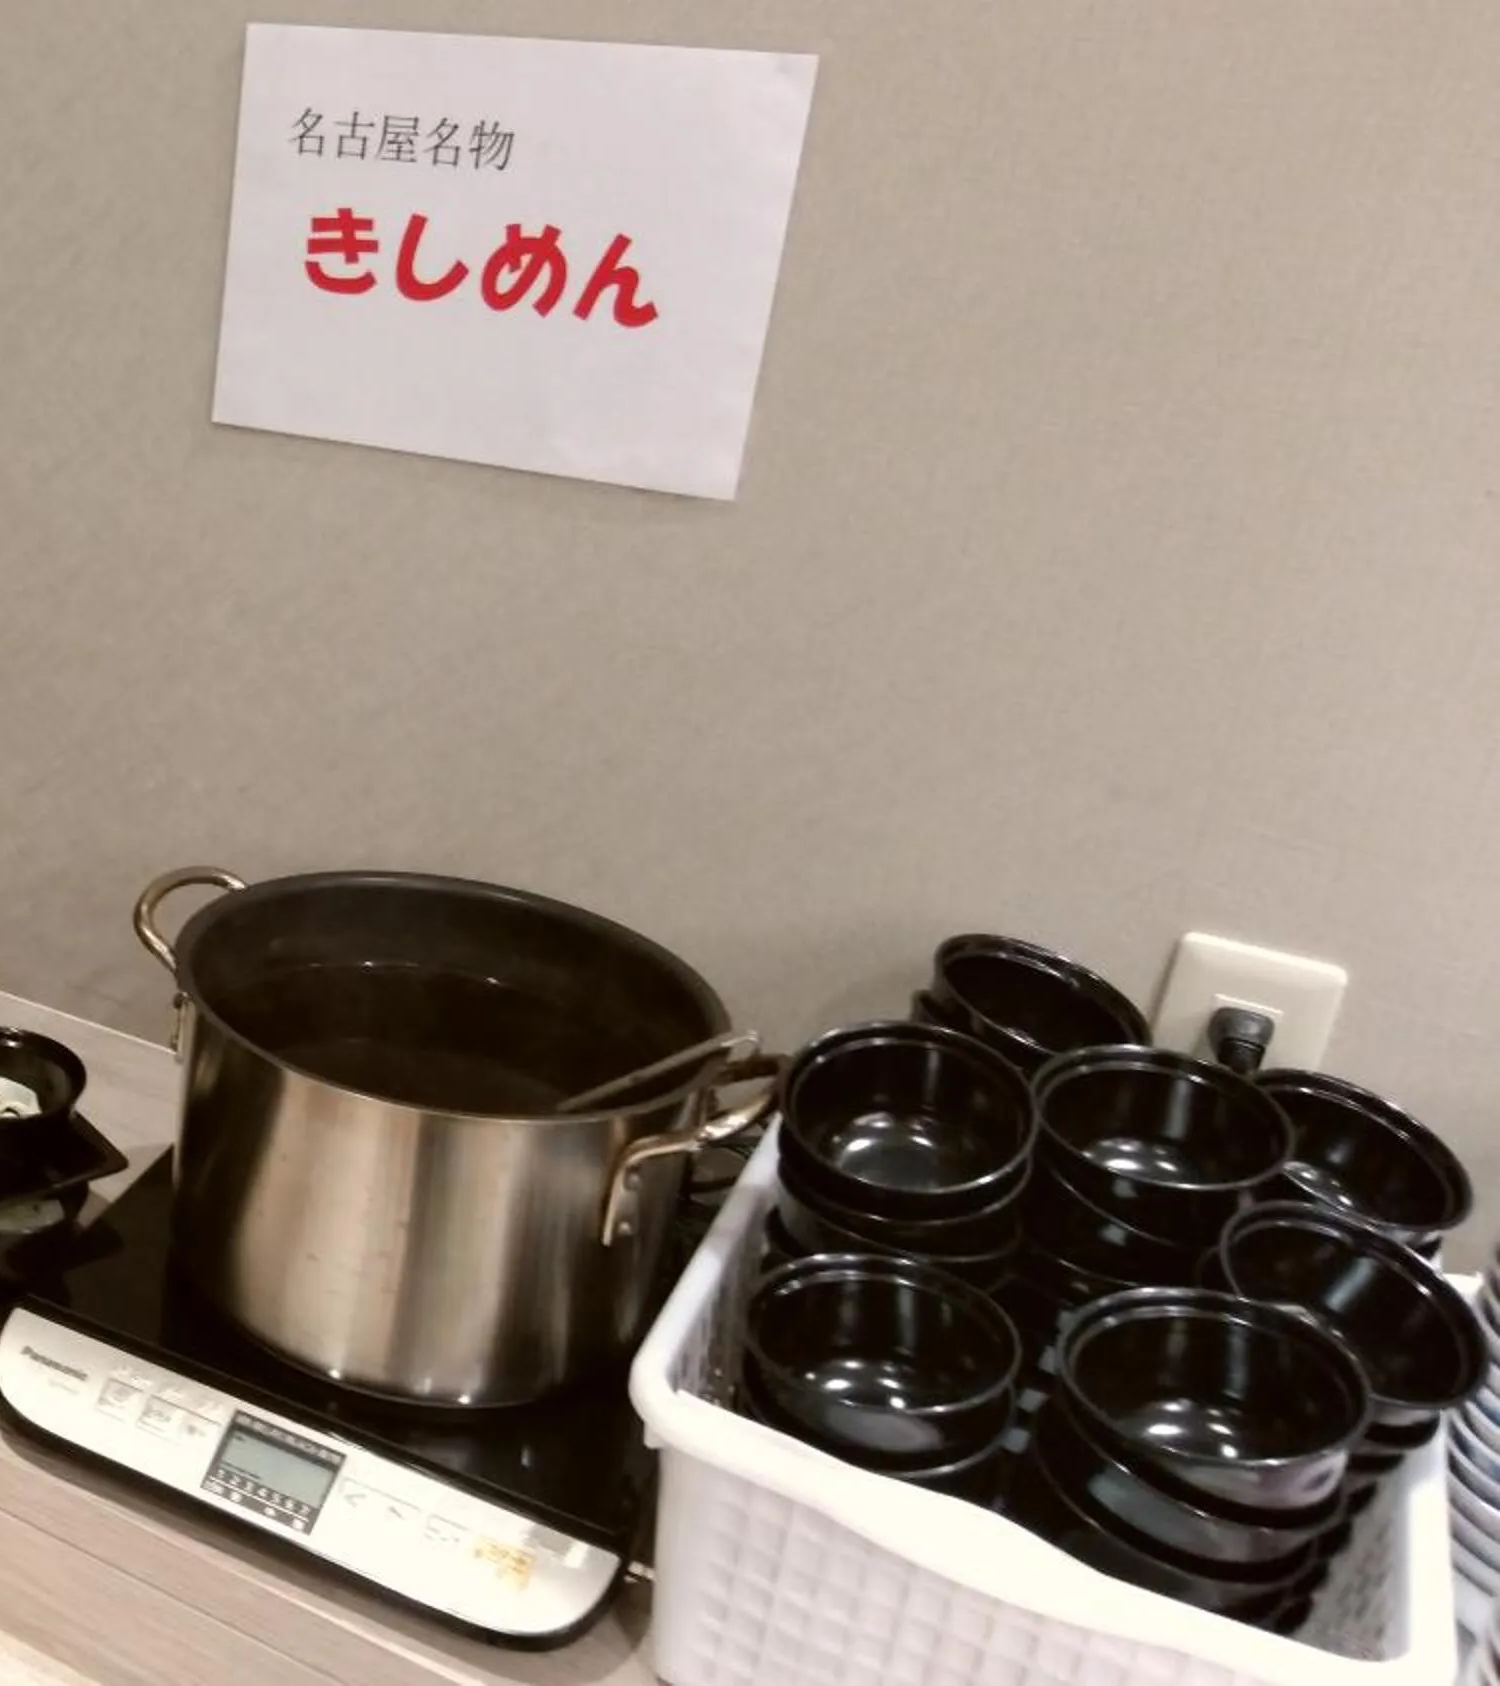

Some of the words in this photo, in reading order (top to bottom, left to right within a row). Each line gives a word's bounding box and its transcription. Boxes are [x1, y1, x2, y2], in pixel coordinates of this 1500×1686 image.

[288, 107, 514, 171] 名古屋名物
[304, 207, 658, 328] きしめん
